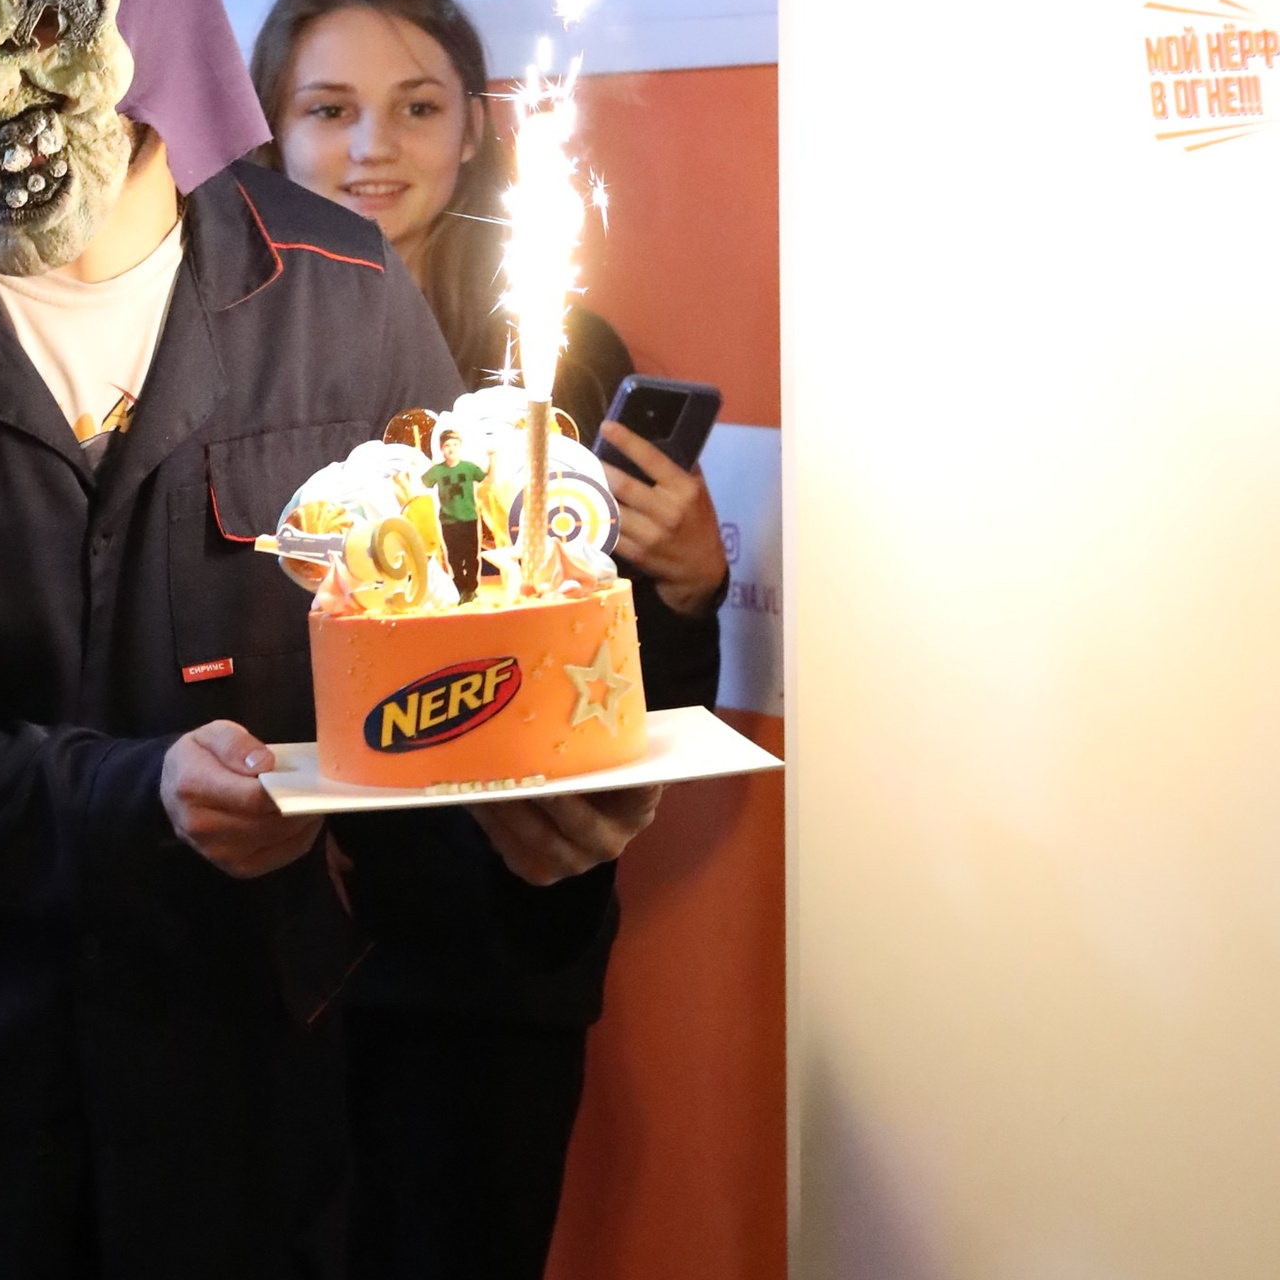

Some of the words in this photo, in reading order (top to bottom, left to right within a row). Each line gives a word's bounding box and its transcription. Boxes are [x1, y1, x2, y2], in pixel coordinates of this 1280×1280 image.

[1145, 26, 1202, 75] МОЙ
[1206, 23, 1280, 70] НЁРФ
[1150, 80, 1169, 119] В
[1173, 75, 1263, 118] ОГНЕ!!!
[188, 663, 225, 675] СИРИУС
[380, 657, 516, 748] NERF
